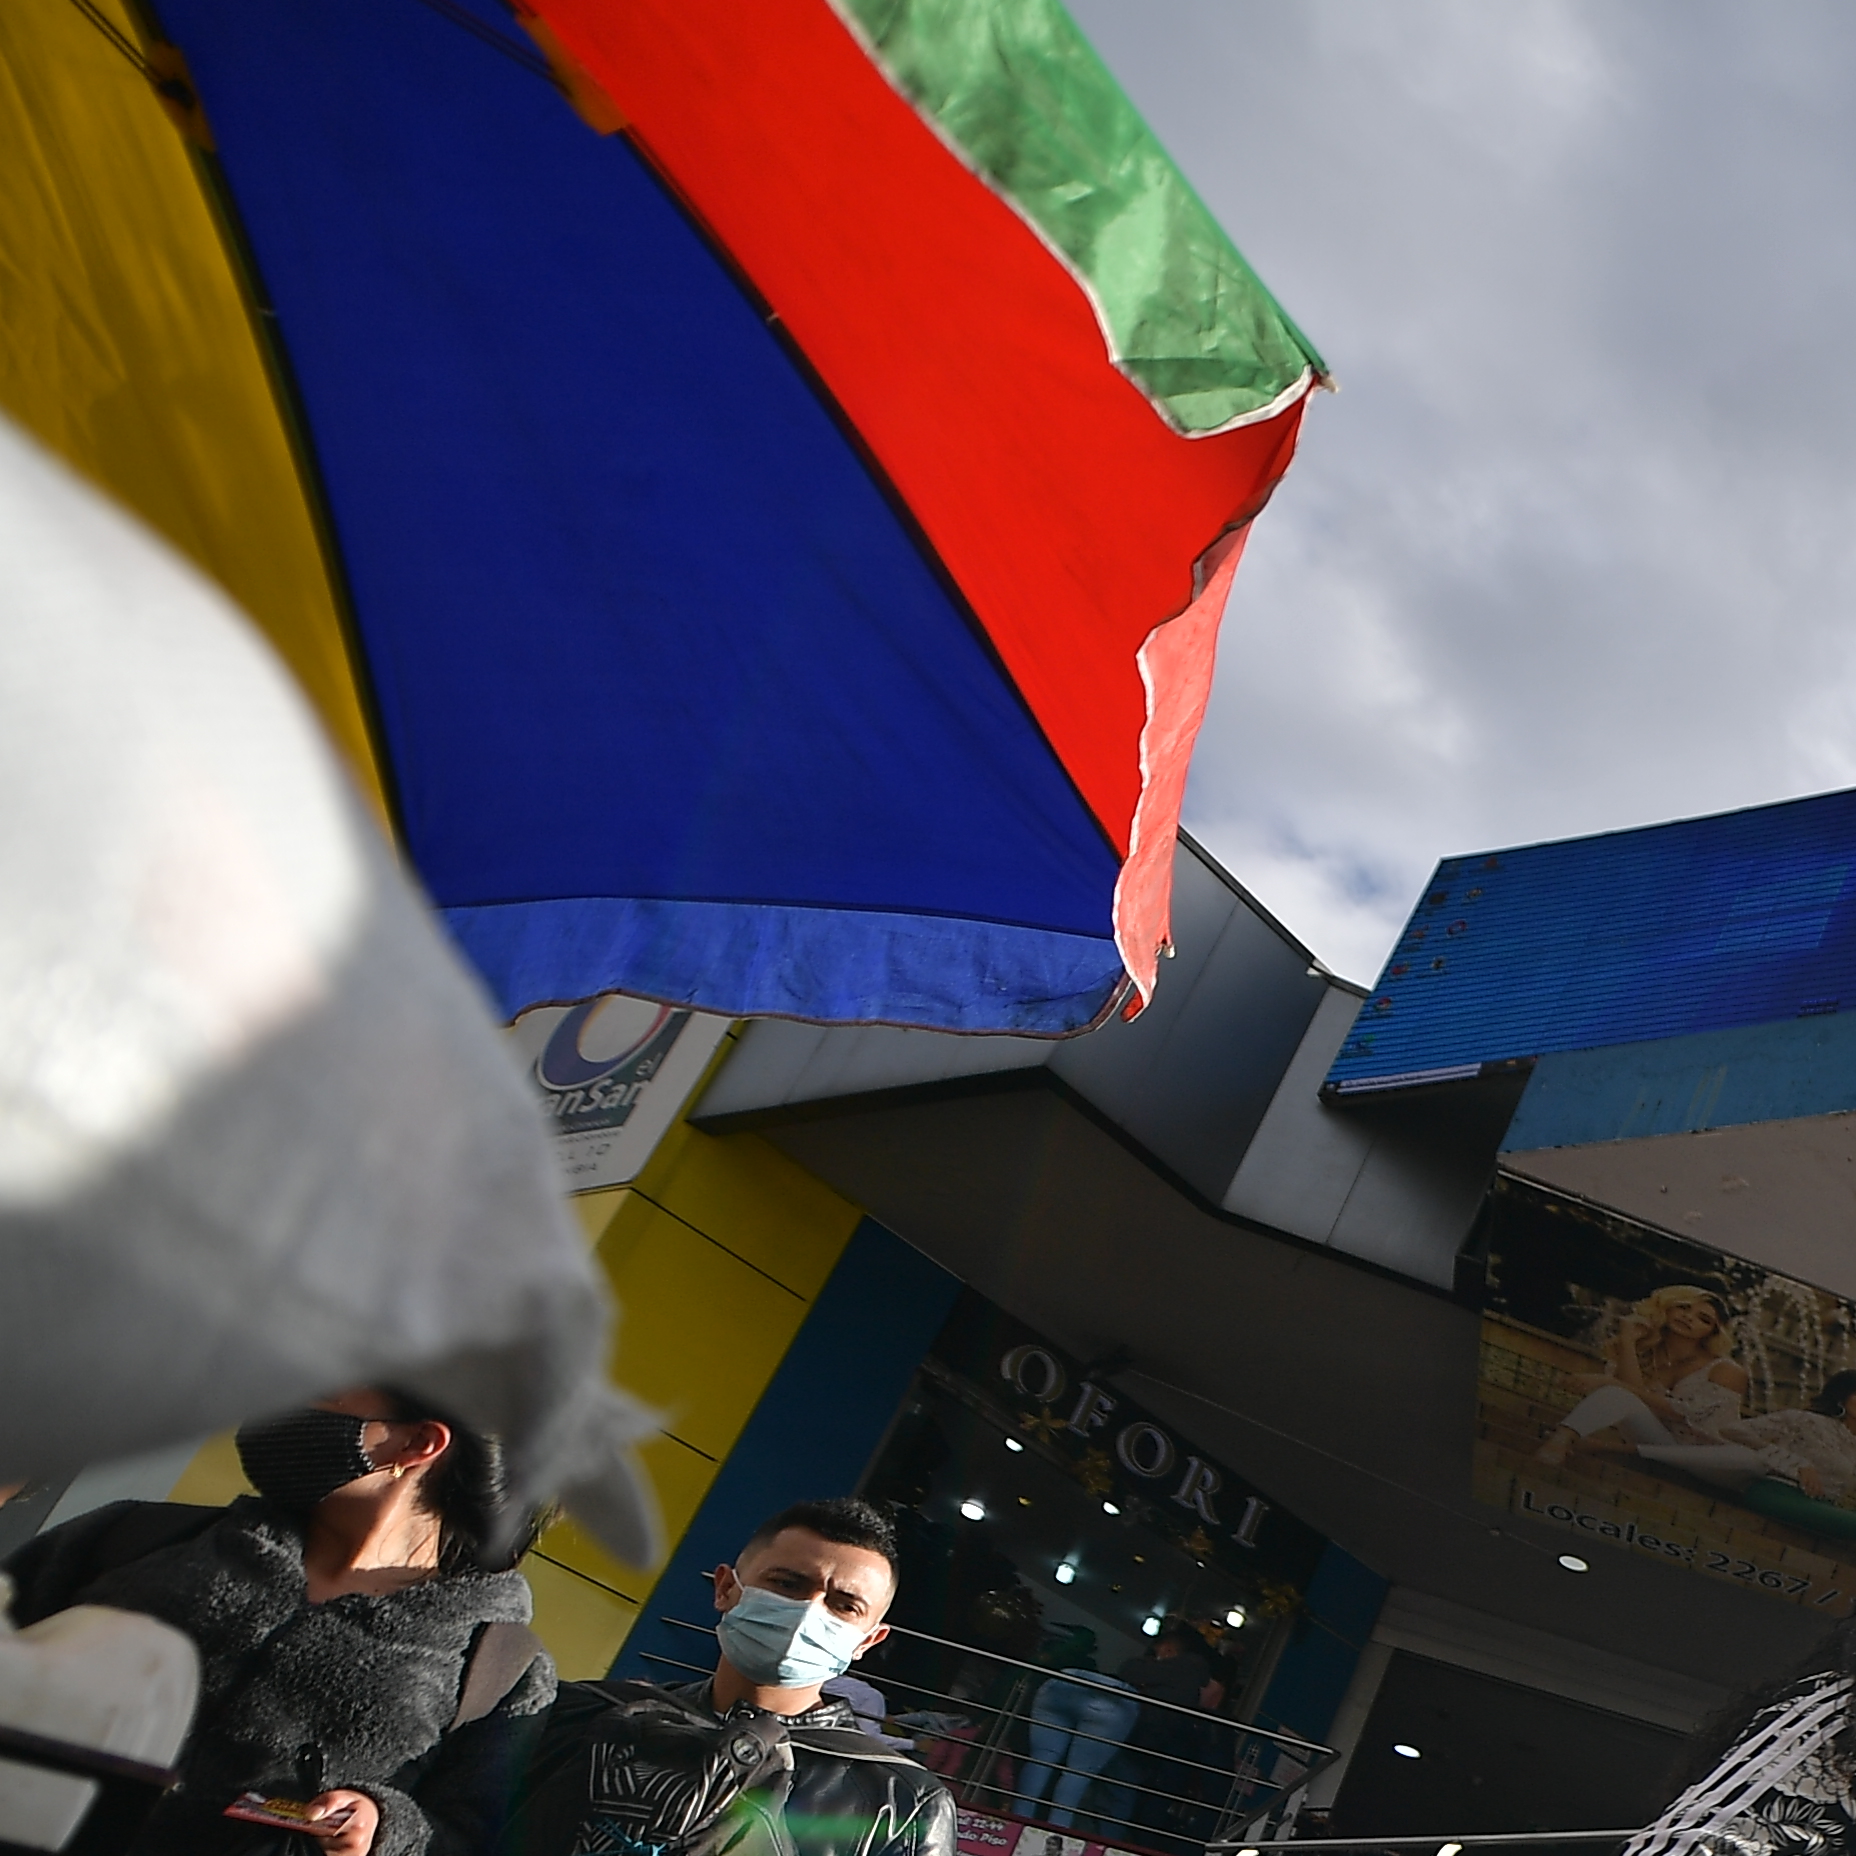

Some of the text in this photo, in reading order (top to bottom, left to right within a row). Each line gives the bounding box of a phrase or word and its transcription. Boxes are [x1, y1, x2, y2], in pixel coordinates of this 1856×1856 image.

[1000, 1344, 1270, 1548] OFORI
[1521, 1490, 1698, 1562] Locales:
[1705, 1550, 1813, 1596] 2267
